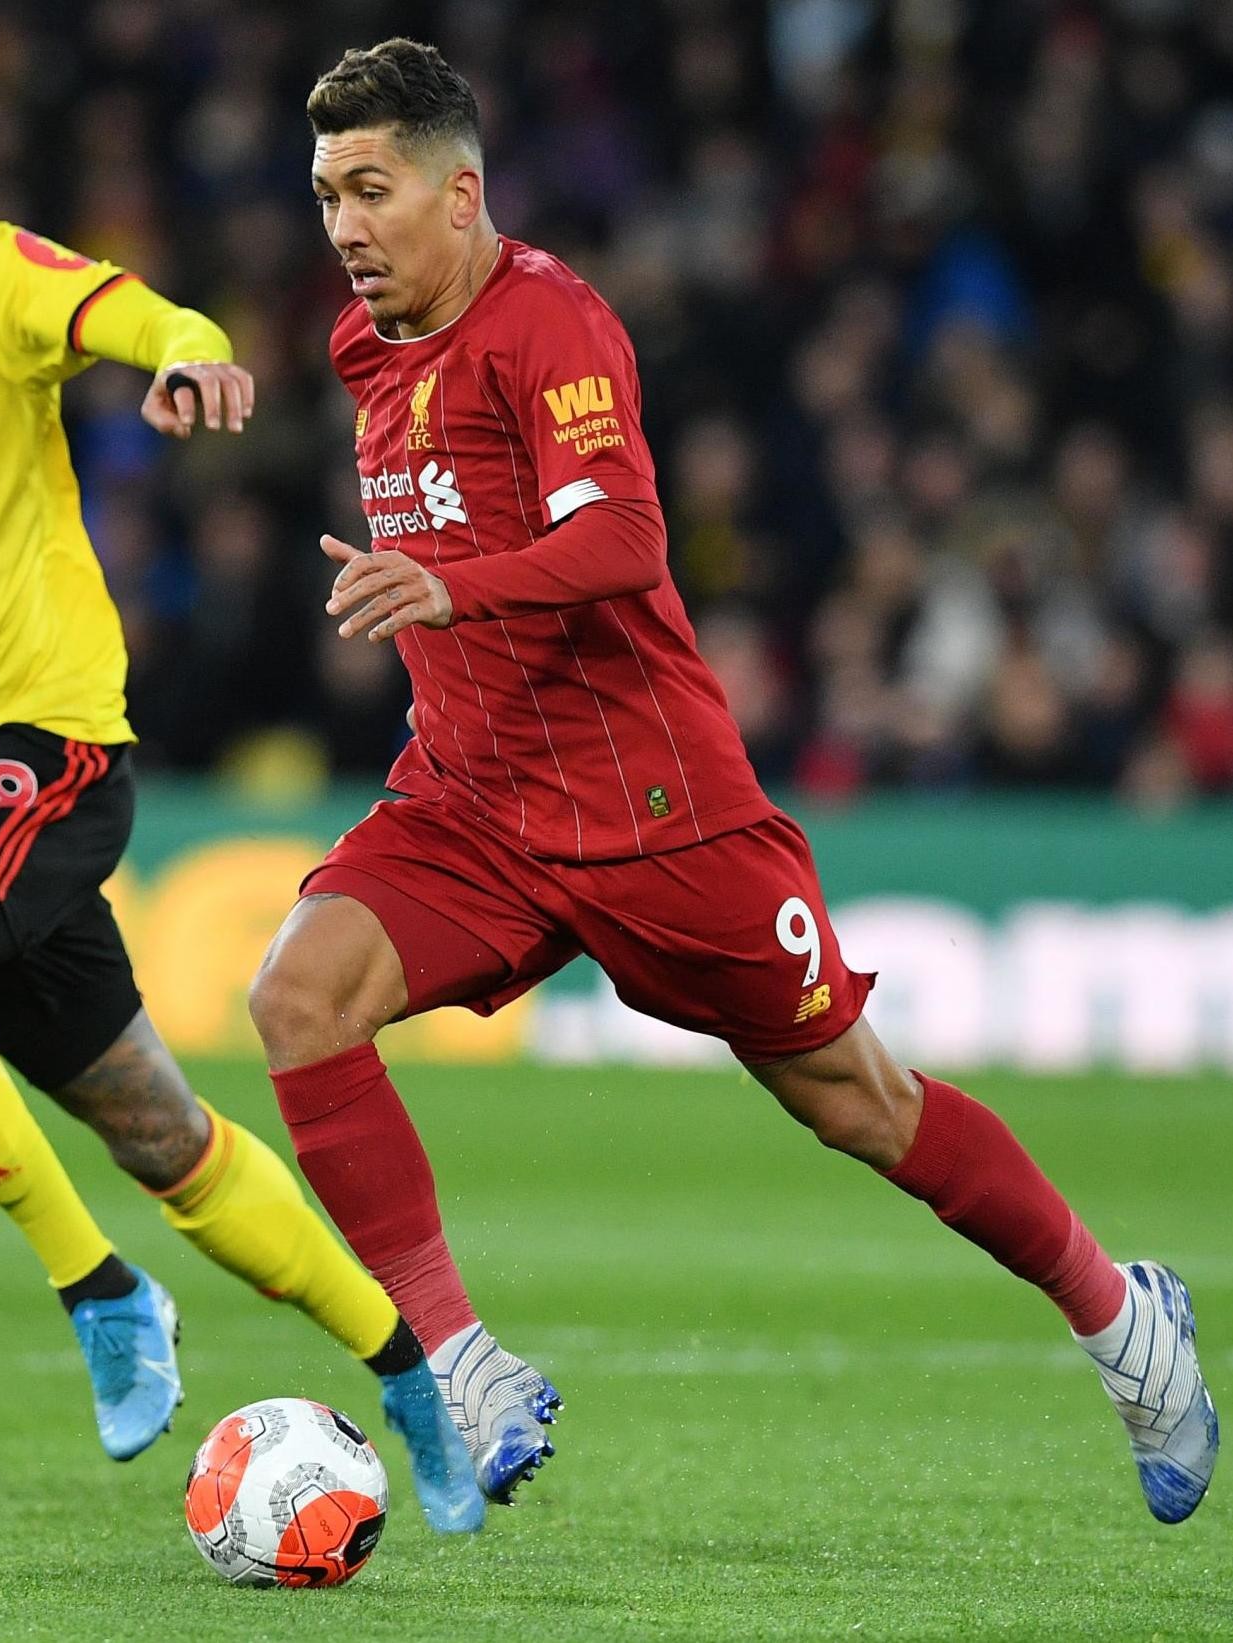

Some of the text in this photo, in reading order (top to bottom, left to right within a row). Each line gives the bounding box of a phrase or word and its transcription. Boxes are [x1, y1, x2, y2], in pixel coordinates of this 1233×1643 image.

[543, 376, 614, 425] WU
[553, 417, 620, 444] Western
[575, 432, 625, 455] Union
[360, 465, 414, 500] andard
[367, 503, 429, 538] artered
[776, 896, 821, 988] 9
